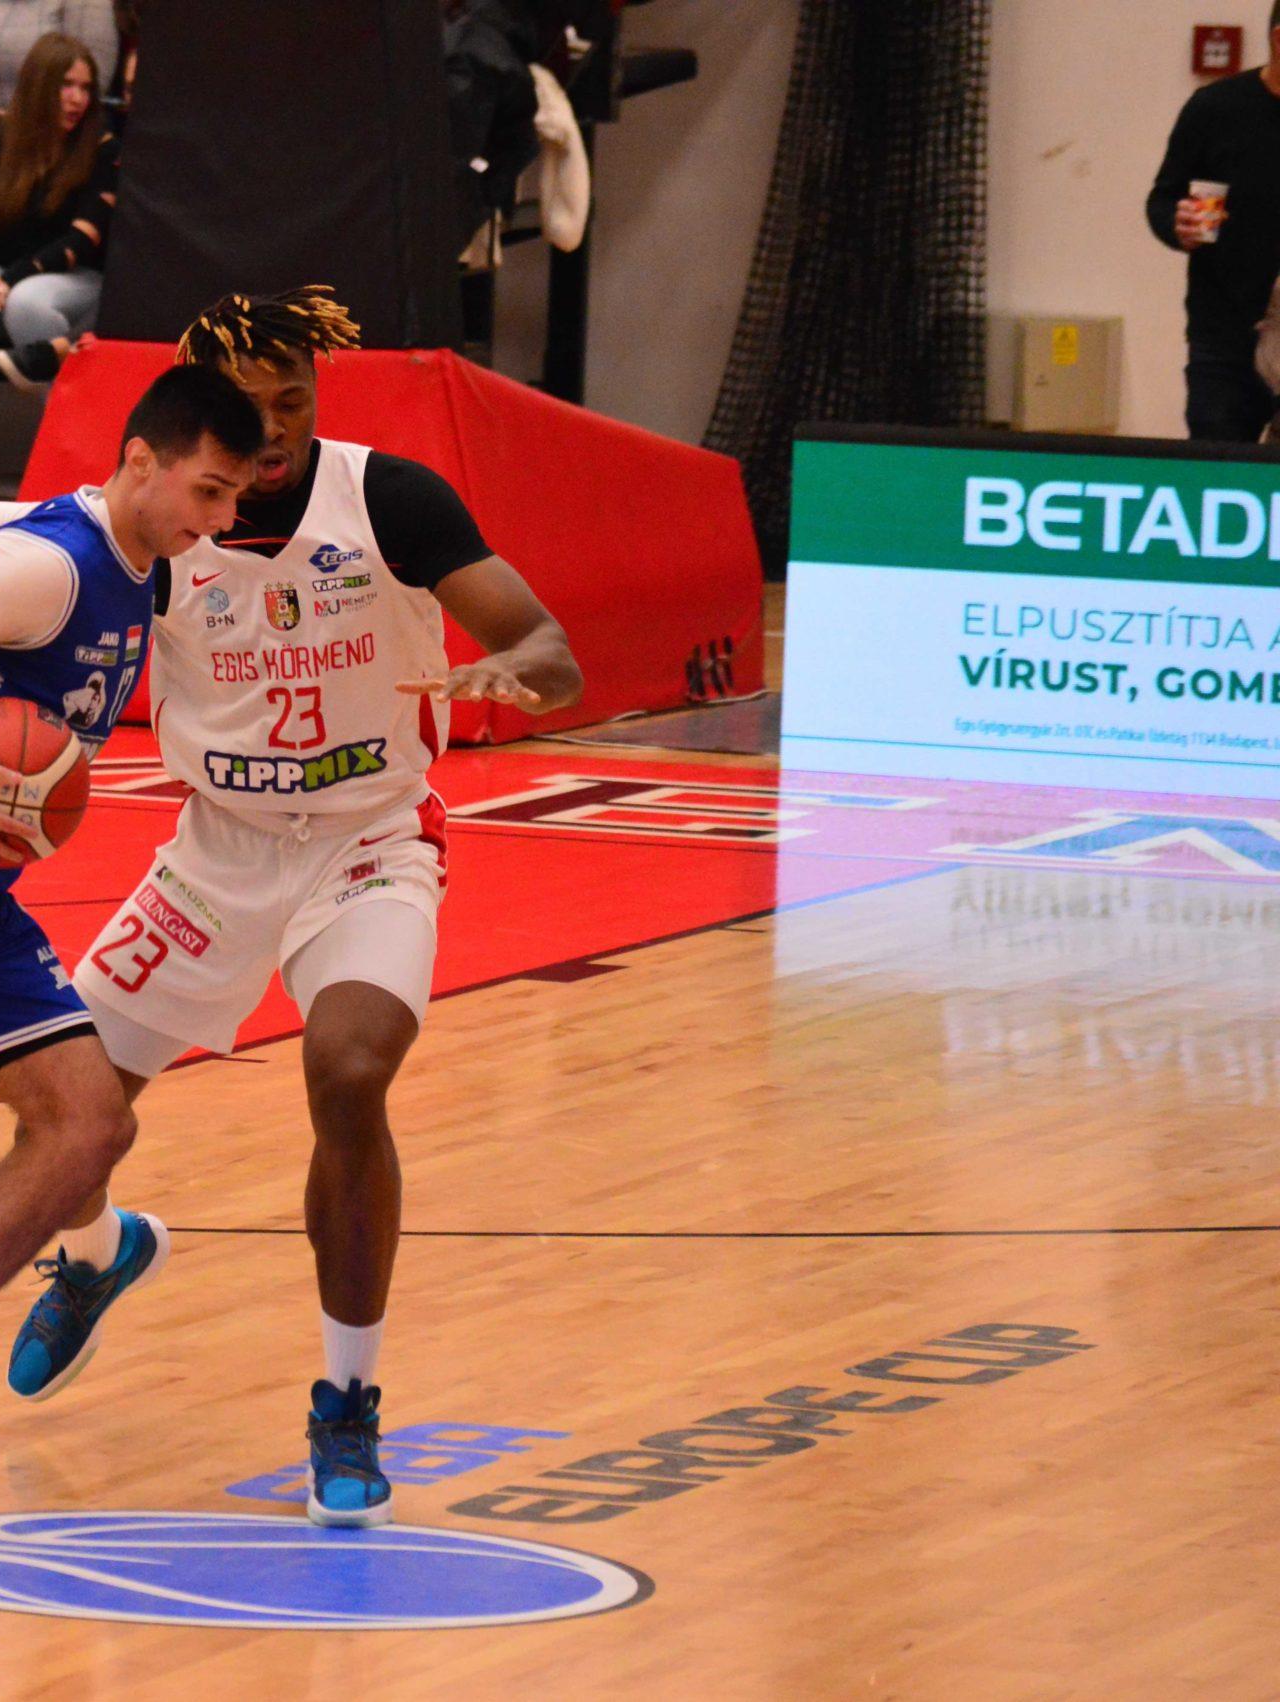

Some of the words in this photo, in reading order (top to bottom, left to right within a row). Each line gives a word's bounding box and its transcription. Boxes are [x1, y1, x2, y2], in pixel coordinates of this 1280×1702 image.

[326, 549, 364, 563] EGIS
[206, 613, 236, 628] B+N
[963, 603, 1255, 650] ELPUSZTÍTJA
[211, 651, 259, 682] EGIS
[262, 632, 376, 681] KÖRMEND
[959, 649, 1139, 703] VÍRUST,
[266, 686, 327, 750] 23
[137, 887, 205, 957] HUNGAST
[91, 914, 169, 993] 23
[446, 1385, 946, 1524] EUROPE
[844, 1322, 1098, 1386] CUP
